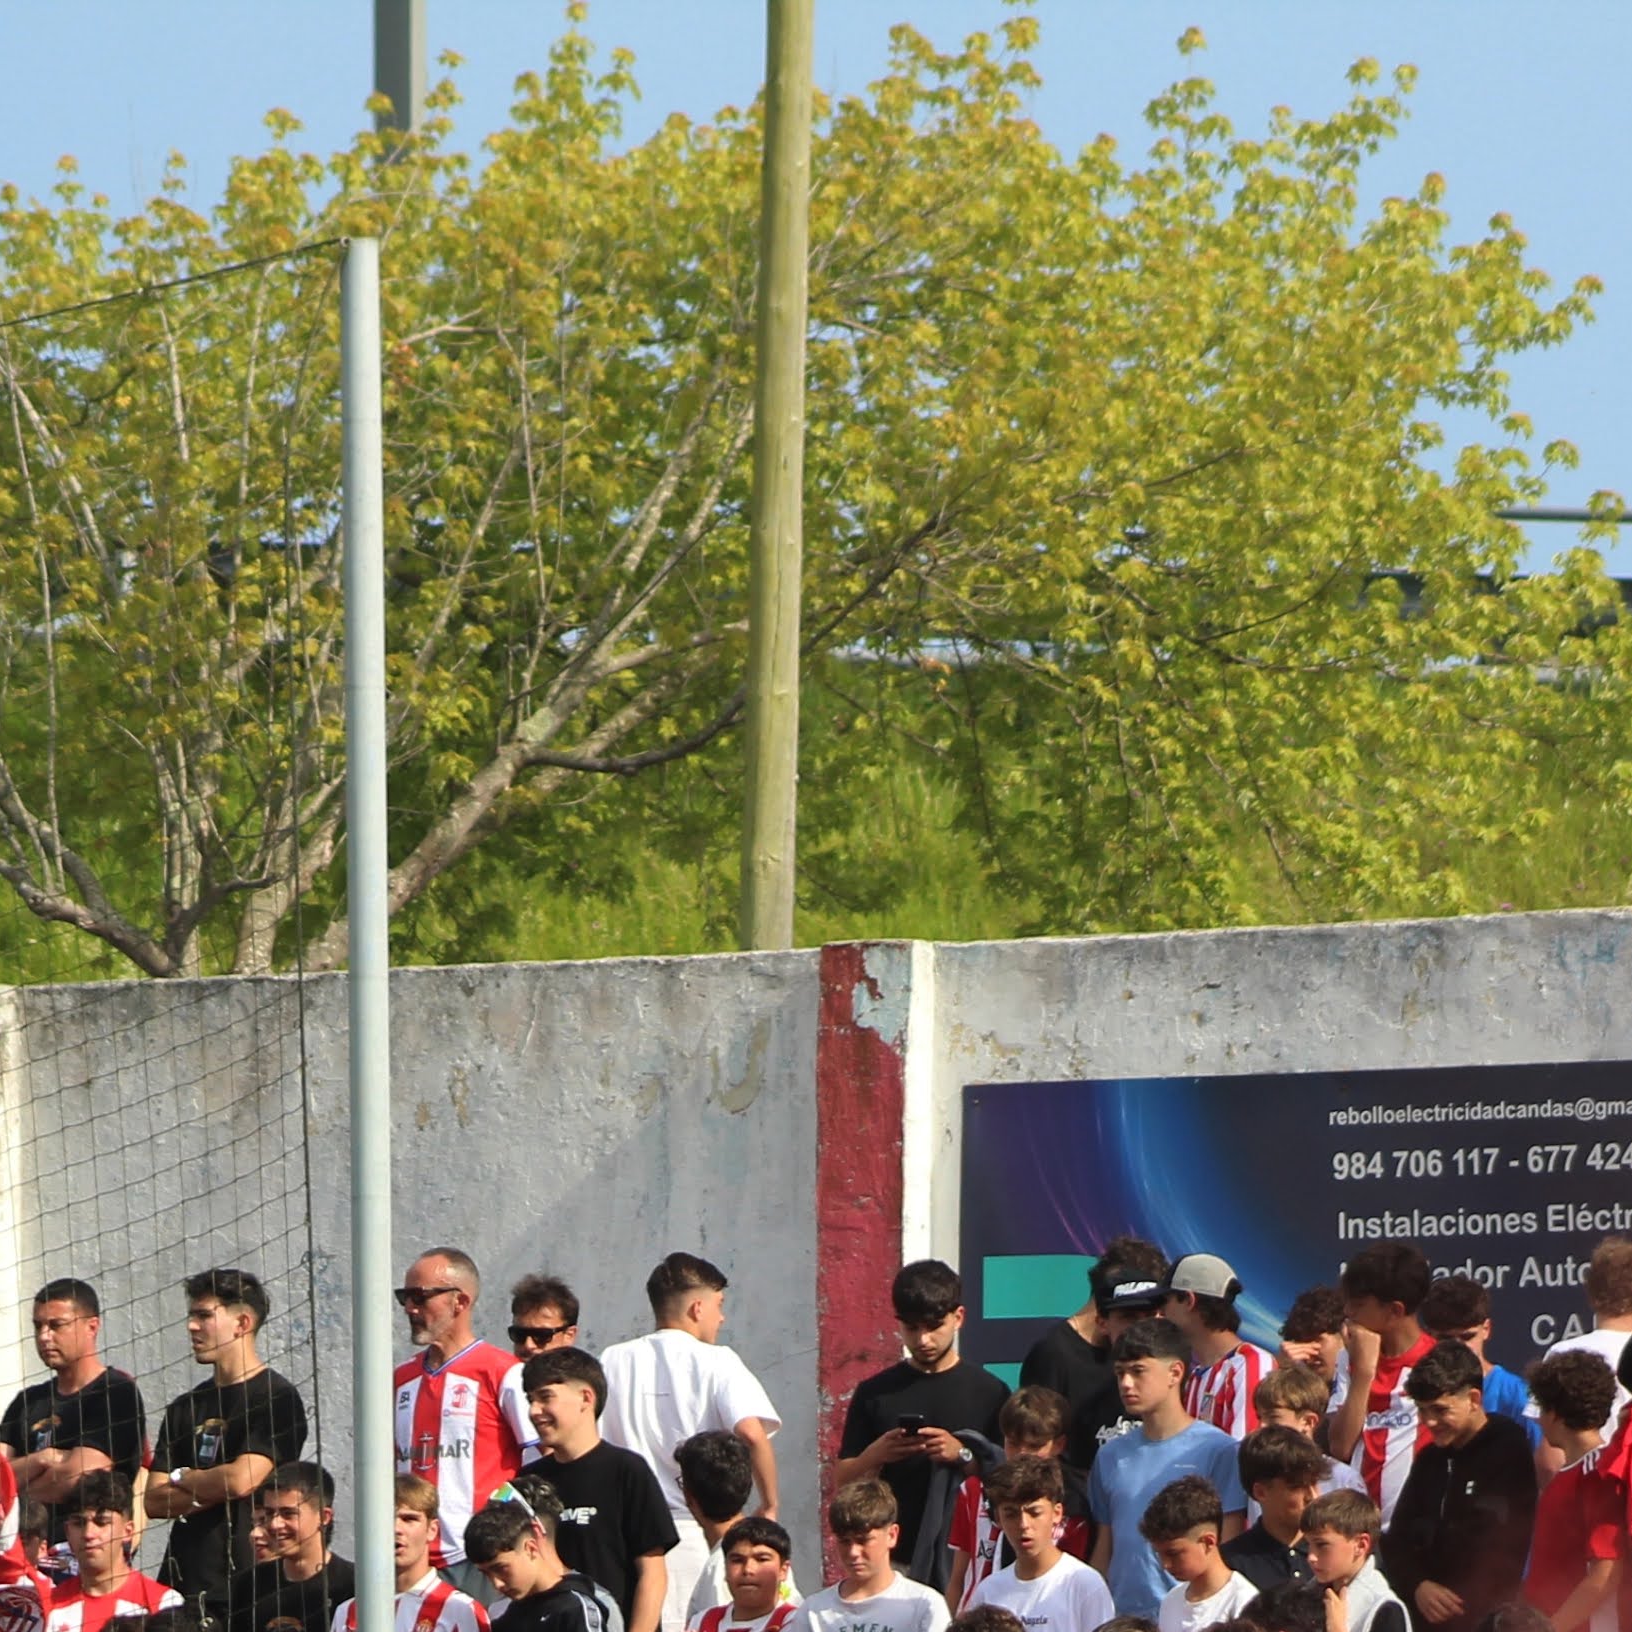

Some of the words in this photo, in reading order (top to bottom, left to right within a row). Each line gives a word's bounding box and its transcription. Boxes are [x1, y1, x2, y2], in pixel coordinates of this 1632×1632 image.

[1333, 1151, 1384, 1181] 984
[1392, 1149, 1443, 1179] 706
[1452, 1147, 1499, 1176] 117
[1527, 1144, 1577, 1173] 677
[1338, 1207, 1538, 1239] Instalaciones
